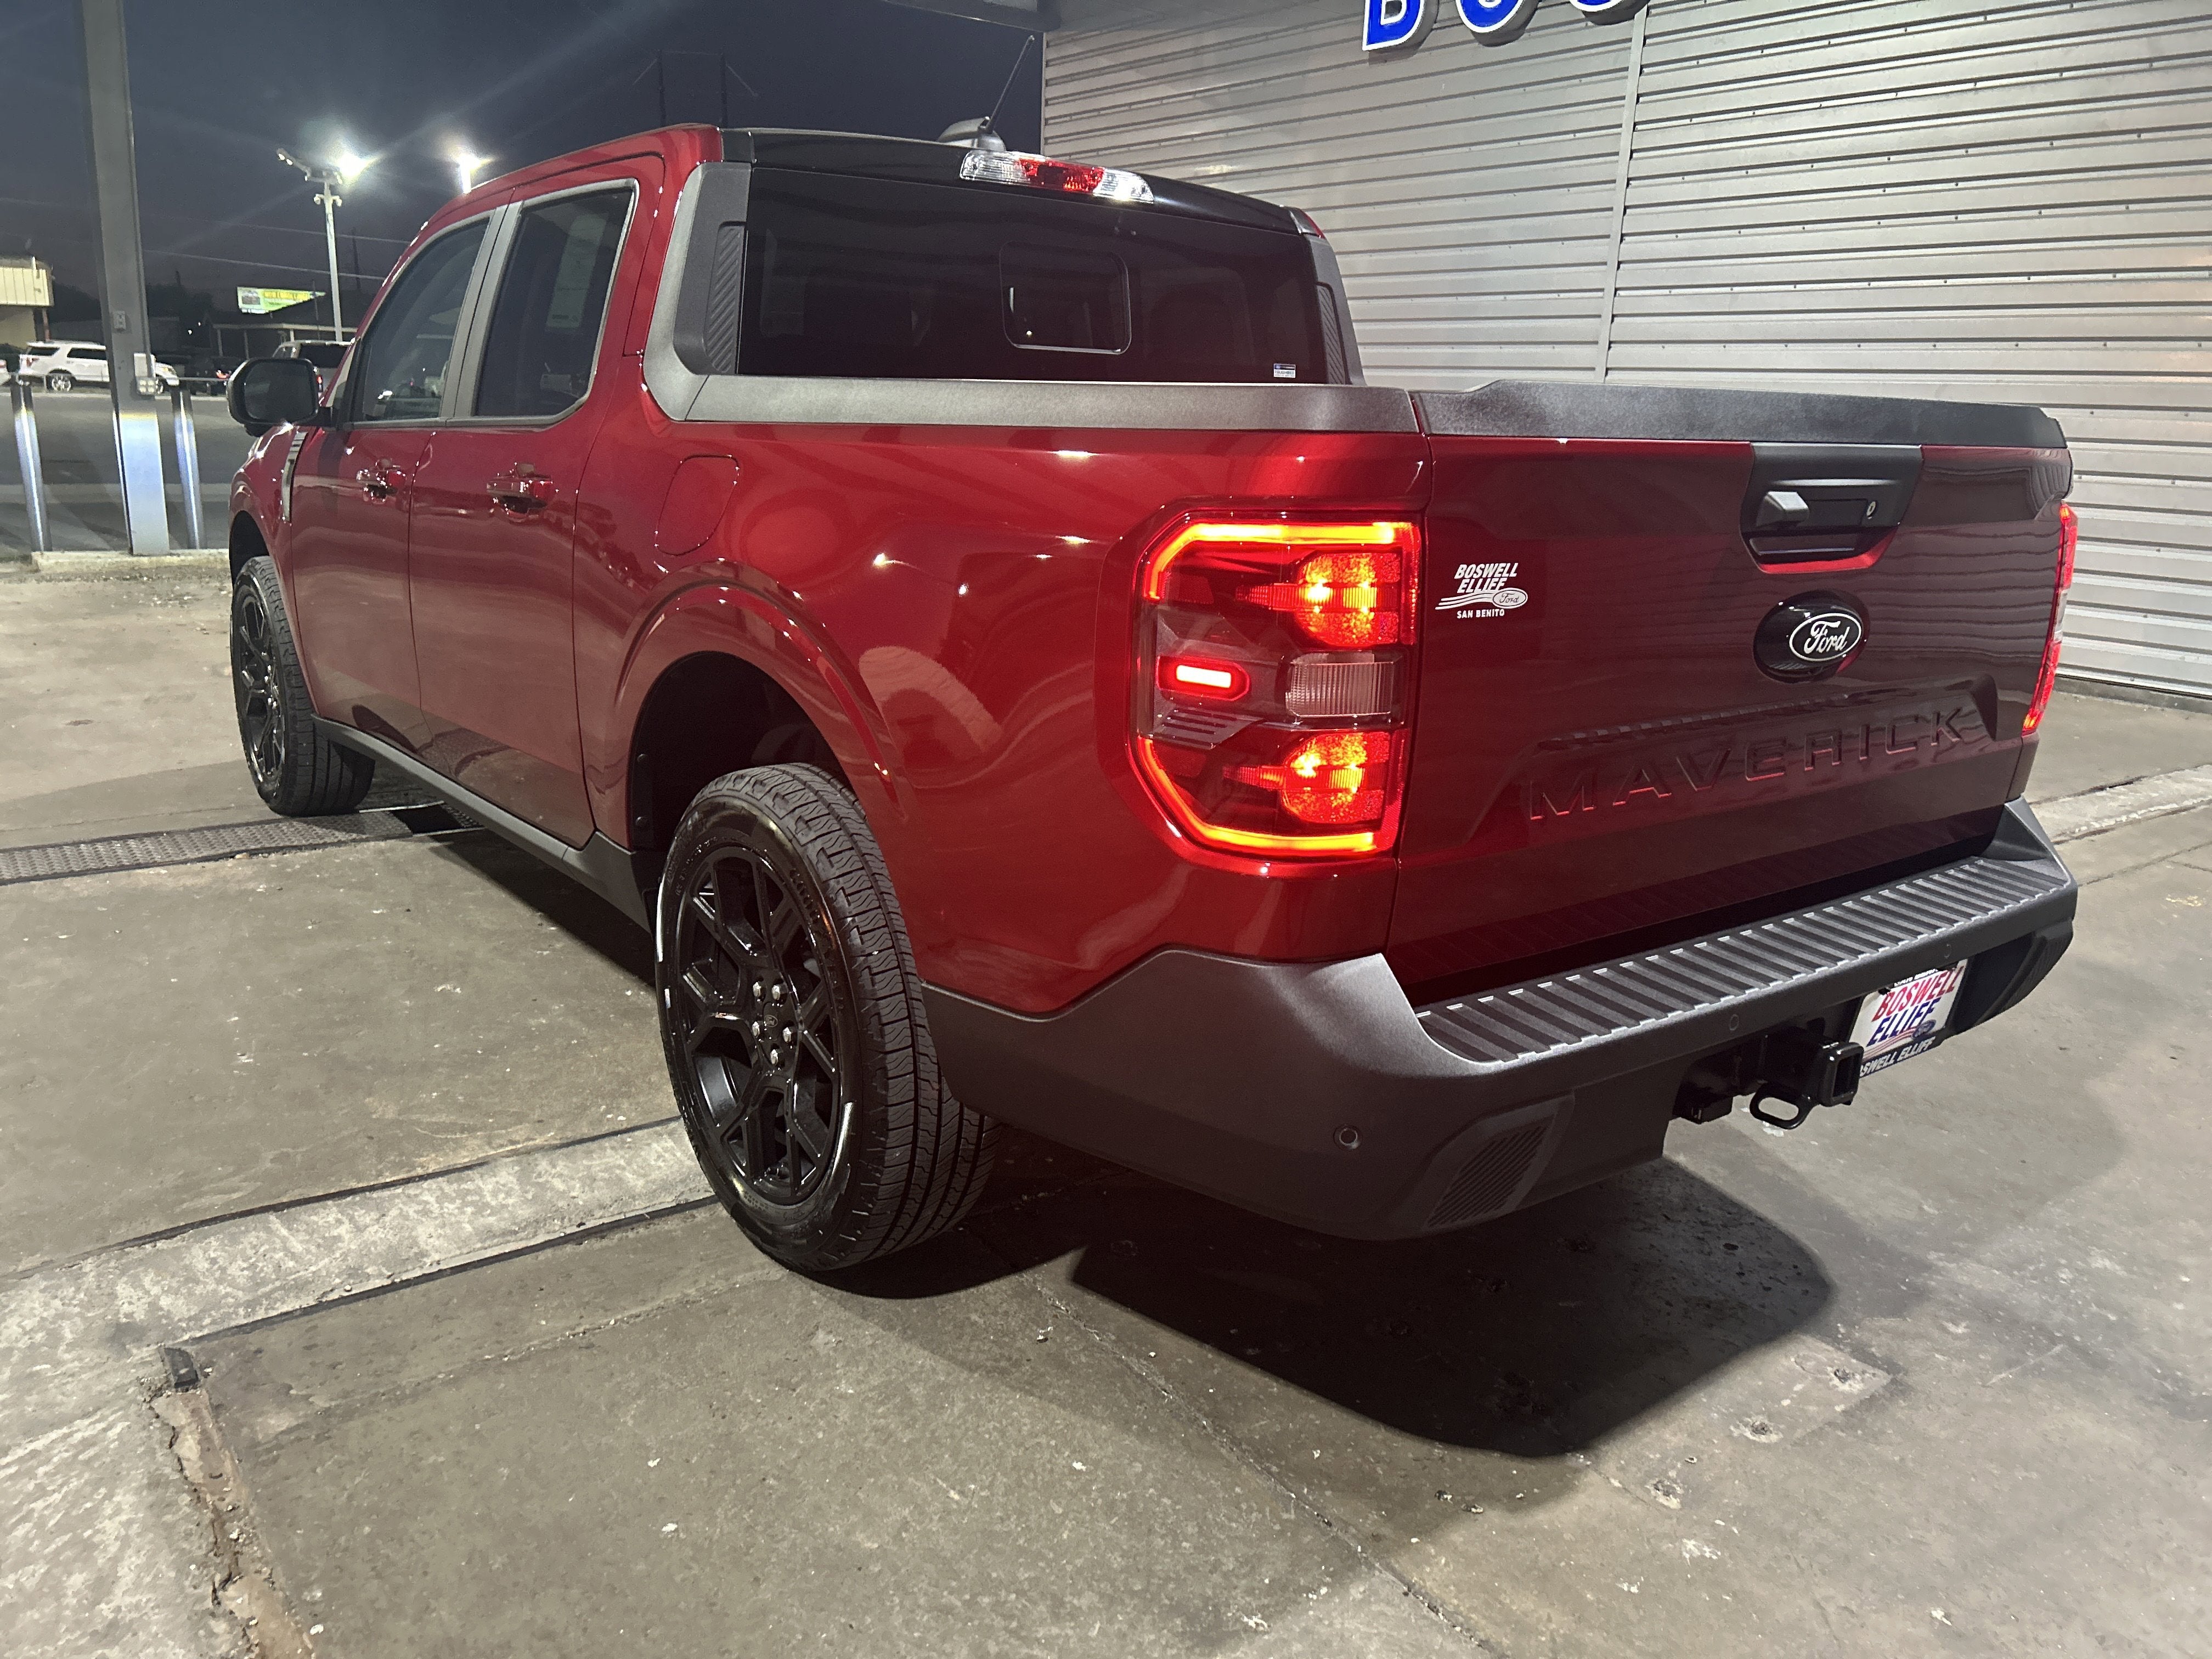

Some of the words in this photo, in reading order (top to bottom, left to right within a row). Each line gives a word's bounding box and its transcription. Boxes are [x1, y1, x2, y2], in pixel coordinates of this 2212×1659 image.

[1454, 562, 1519, 579] BOSWELL
[1457, 610, 1474, 619] SAN
[1476, 608, 1505, 618] BENITO
[1499, 592, 1520, 603] Ford
[1803, 620, 1850, 654] Ford
[1529, 707, 1963, 820] MAVERICK
[1871, 965, 1965, 1022] BOSWELL
[1866, 997, 1942, 1047] ELLIFF
